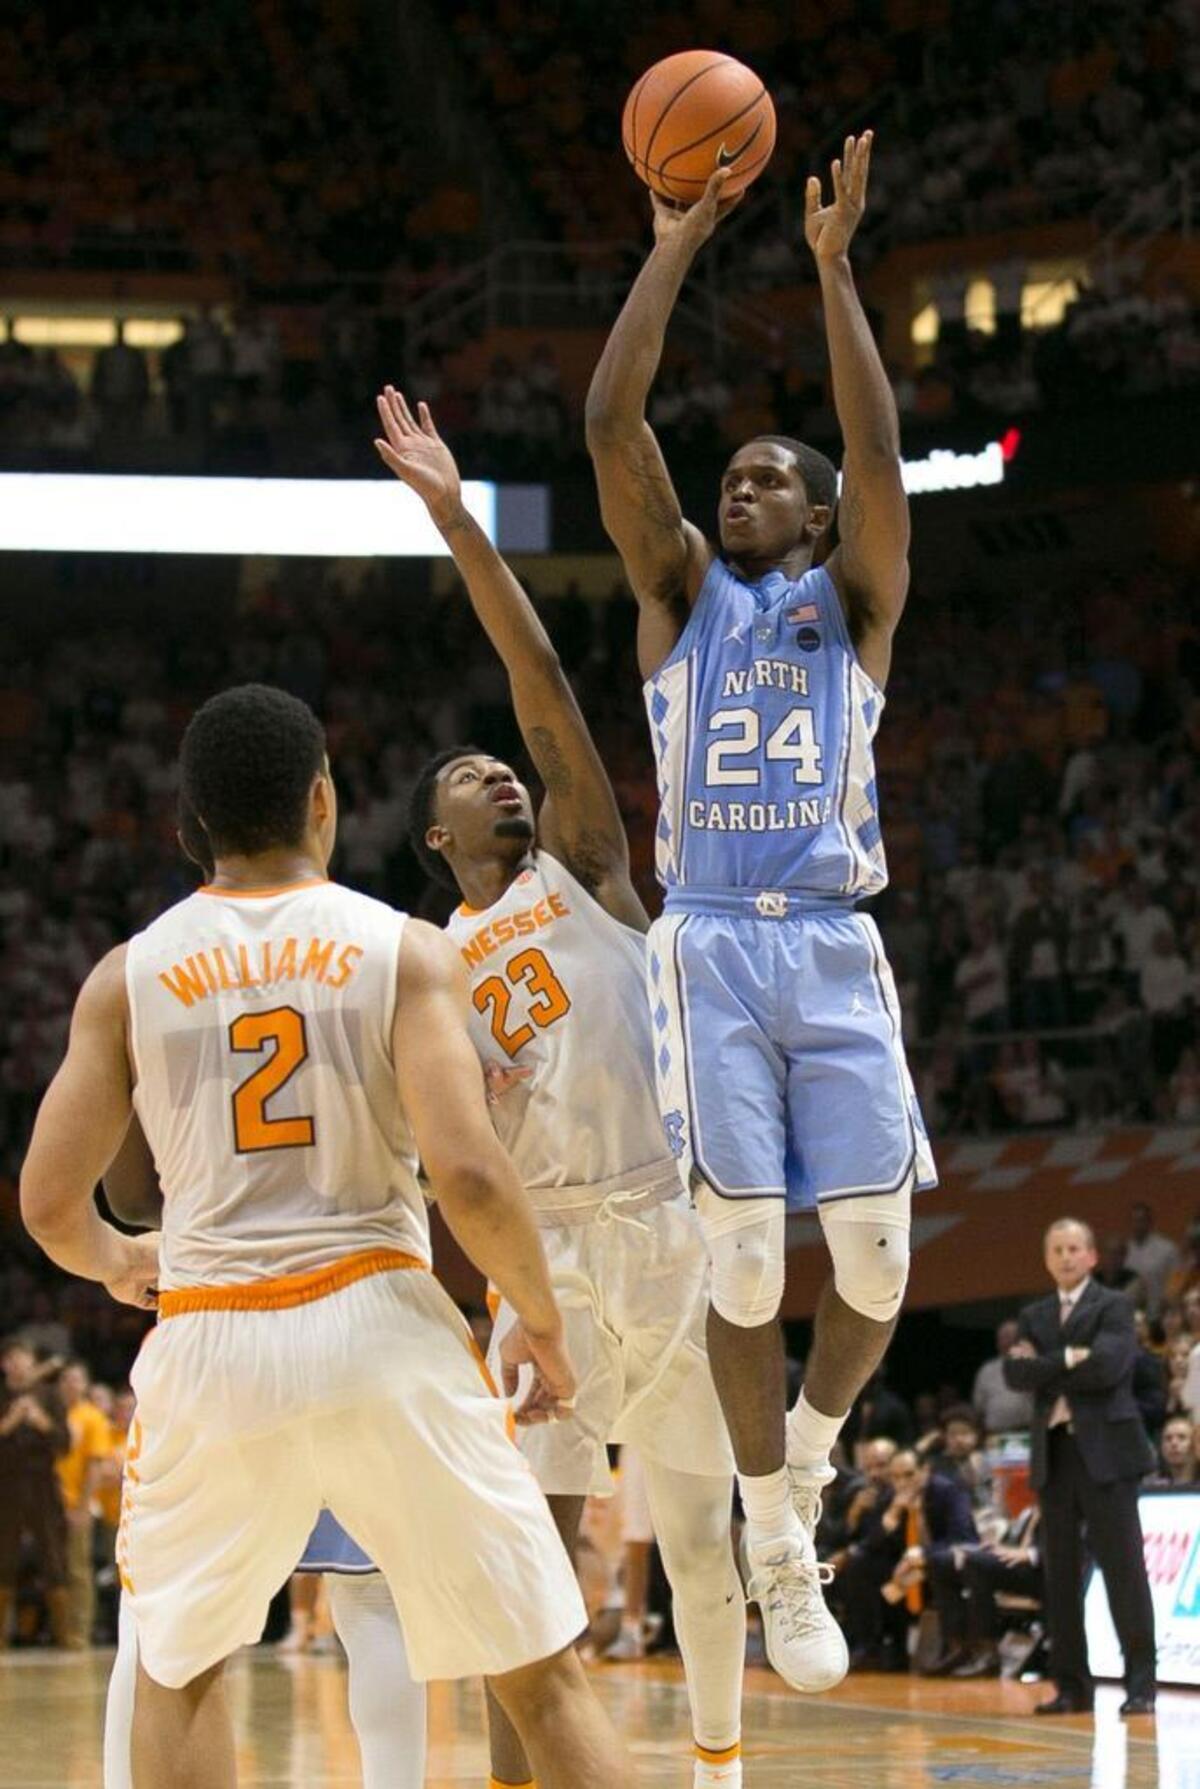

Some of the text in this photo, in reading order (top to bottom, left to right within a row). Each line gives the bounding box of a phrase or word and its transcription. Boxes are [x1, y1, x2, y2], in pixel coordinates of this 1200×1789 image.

[705, 706, 824, 787] 24
[460, 892, 572, 970] NESSEE
[158, 937, 364, 1008] WILLIAMS
[472, 947, 572, 1060] 23
[229, 1005, 316, 1155] 2
